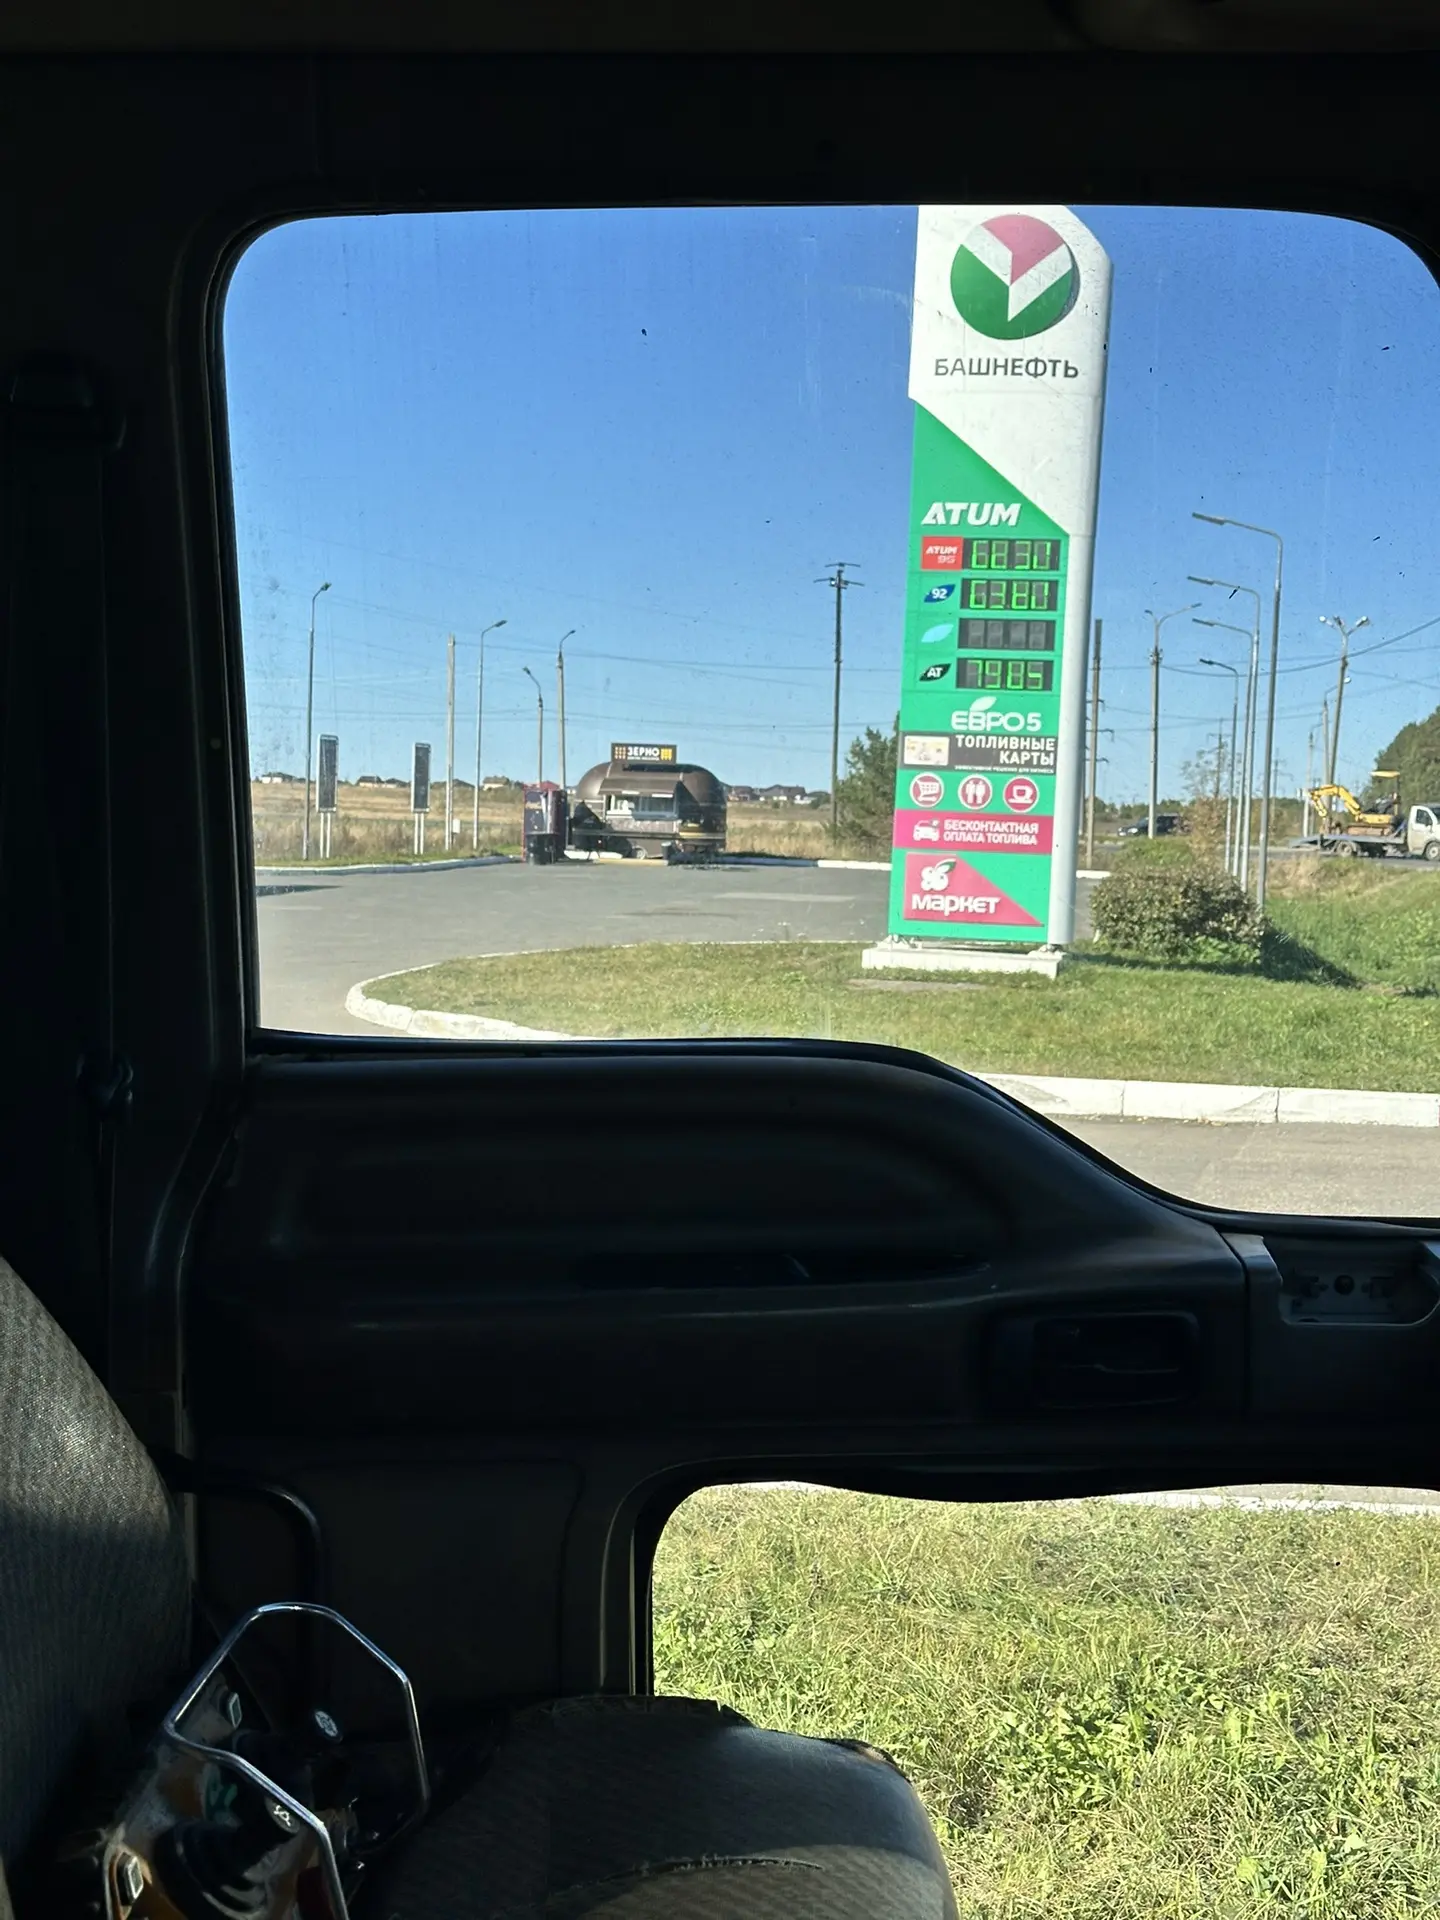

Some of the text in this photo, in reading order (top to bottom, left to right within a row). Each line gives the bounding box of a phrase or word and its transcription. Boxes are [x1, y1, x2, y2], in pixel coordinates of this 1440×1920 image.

[934, 358, 1079, 379] БАШНЕФТЬ
[922, 502, 1021, 527] ATUM
[926, 546, 958, 555] ATUM
[931, 588, 948, 599] 92
[1026, 712, 1042, 731] 5
[956, 734, 1056, 751] ТОПЛИВНЫЕ
[627, 746, 660, 757] ЗЕРНО
[999, 750, 1054, 766] КАРТЫ
[944, 819, 1039, 834] БЕСКОНТАКТНАЯ
[943, 831, 1038, 846] ОПЛАТА ТОПЛИВА
